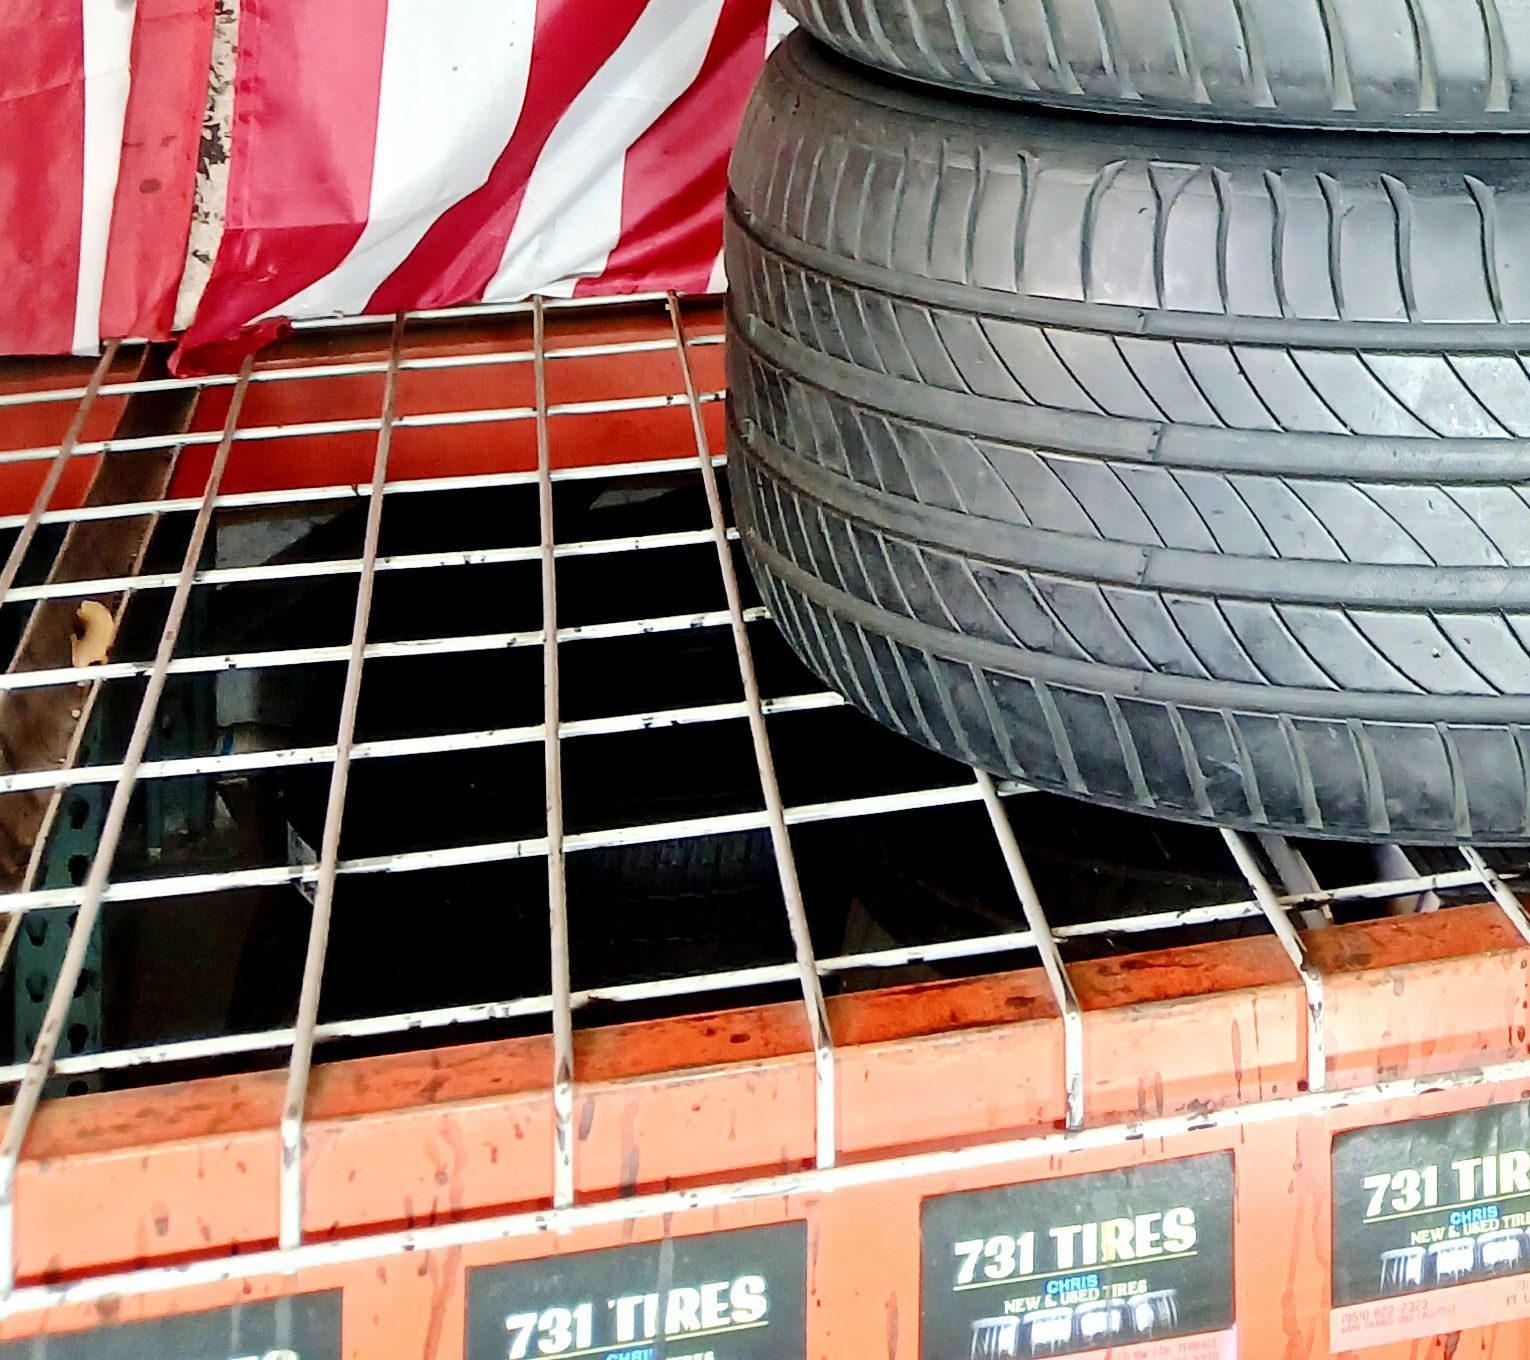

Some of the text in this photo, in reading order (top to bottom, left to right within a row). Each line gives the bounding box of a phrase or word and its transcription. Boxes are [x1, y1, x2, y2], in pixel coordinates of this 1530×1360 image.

[1363, 1165, 1437, 1217] 731
[1411, 1227, 1448, 1245] NEW
[1463, 1218, 1500, 1237] USED
[1450, 1205, 1499, 1225] CHRIS
[954, 1206, 1198, 1285] 731 TIRES
[1004, 1296, 1041, 1315] NEW
[1060, 1288, 1100, 1306] USED
[1103, 1279, 1148, 1297] TIRES
[1047, 1274, 1099, 1294] CHRIS
[505, 1275, 769, 1359] 731 TIRES
